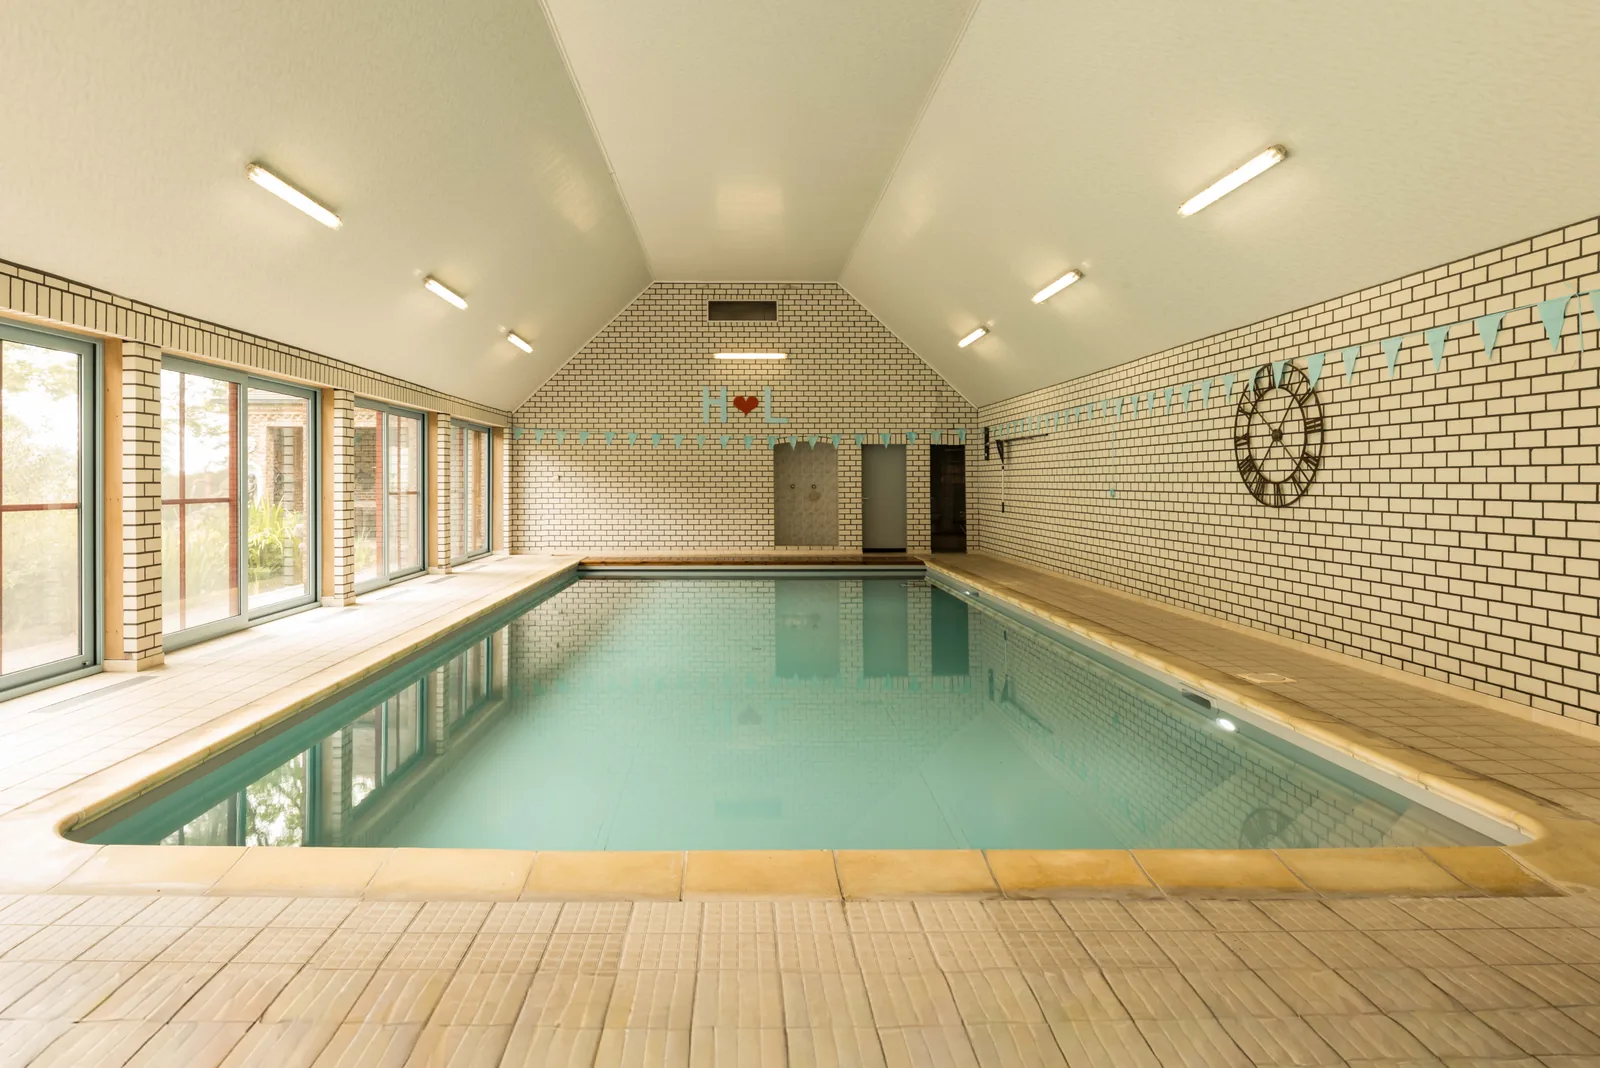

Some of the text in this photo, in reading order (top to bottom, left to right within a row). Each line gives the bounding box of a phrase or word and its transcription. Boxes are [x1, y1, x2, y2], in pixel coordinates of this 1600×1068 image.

[703, 385, 789, 423] H L
[1304, 419, 1322, 434] III
